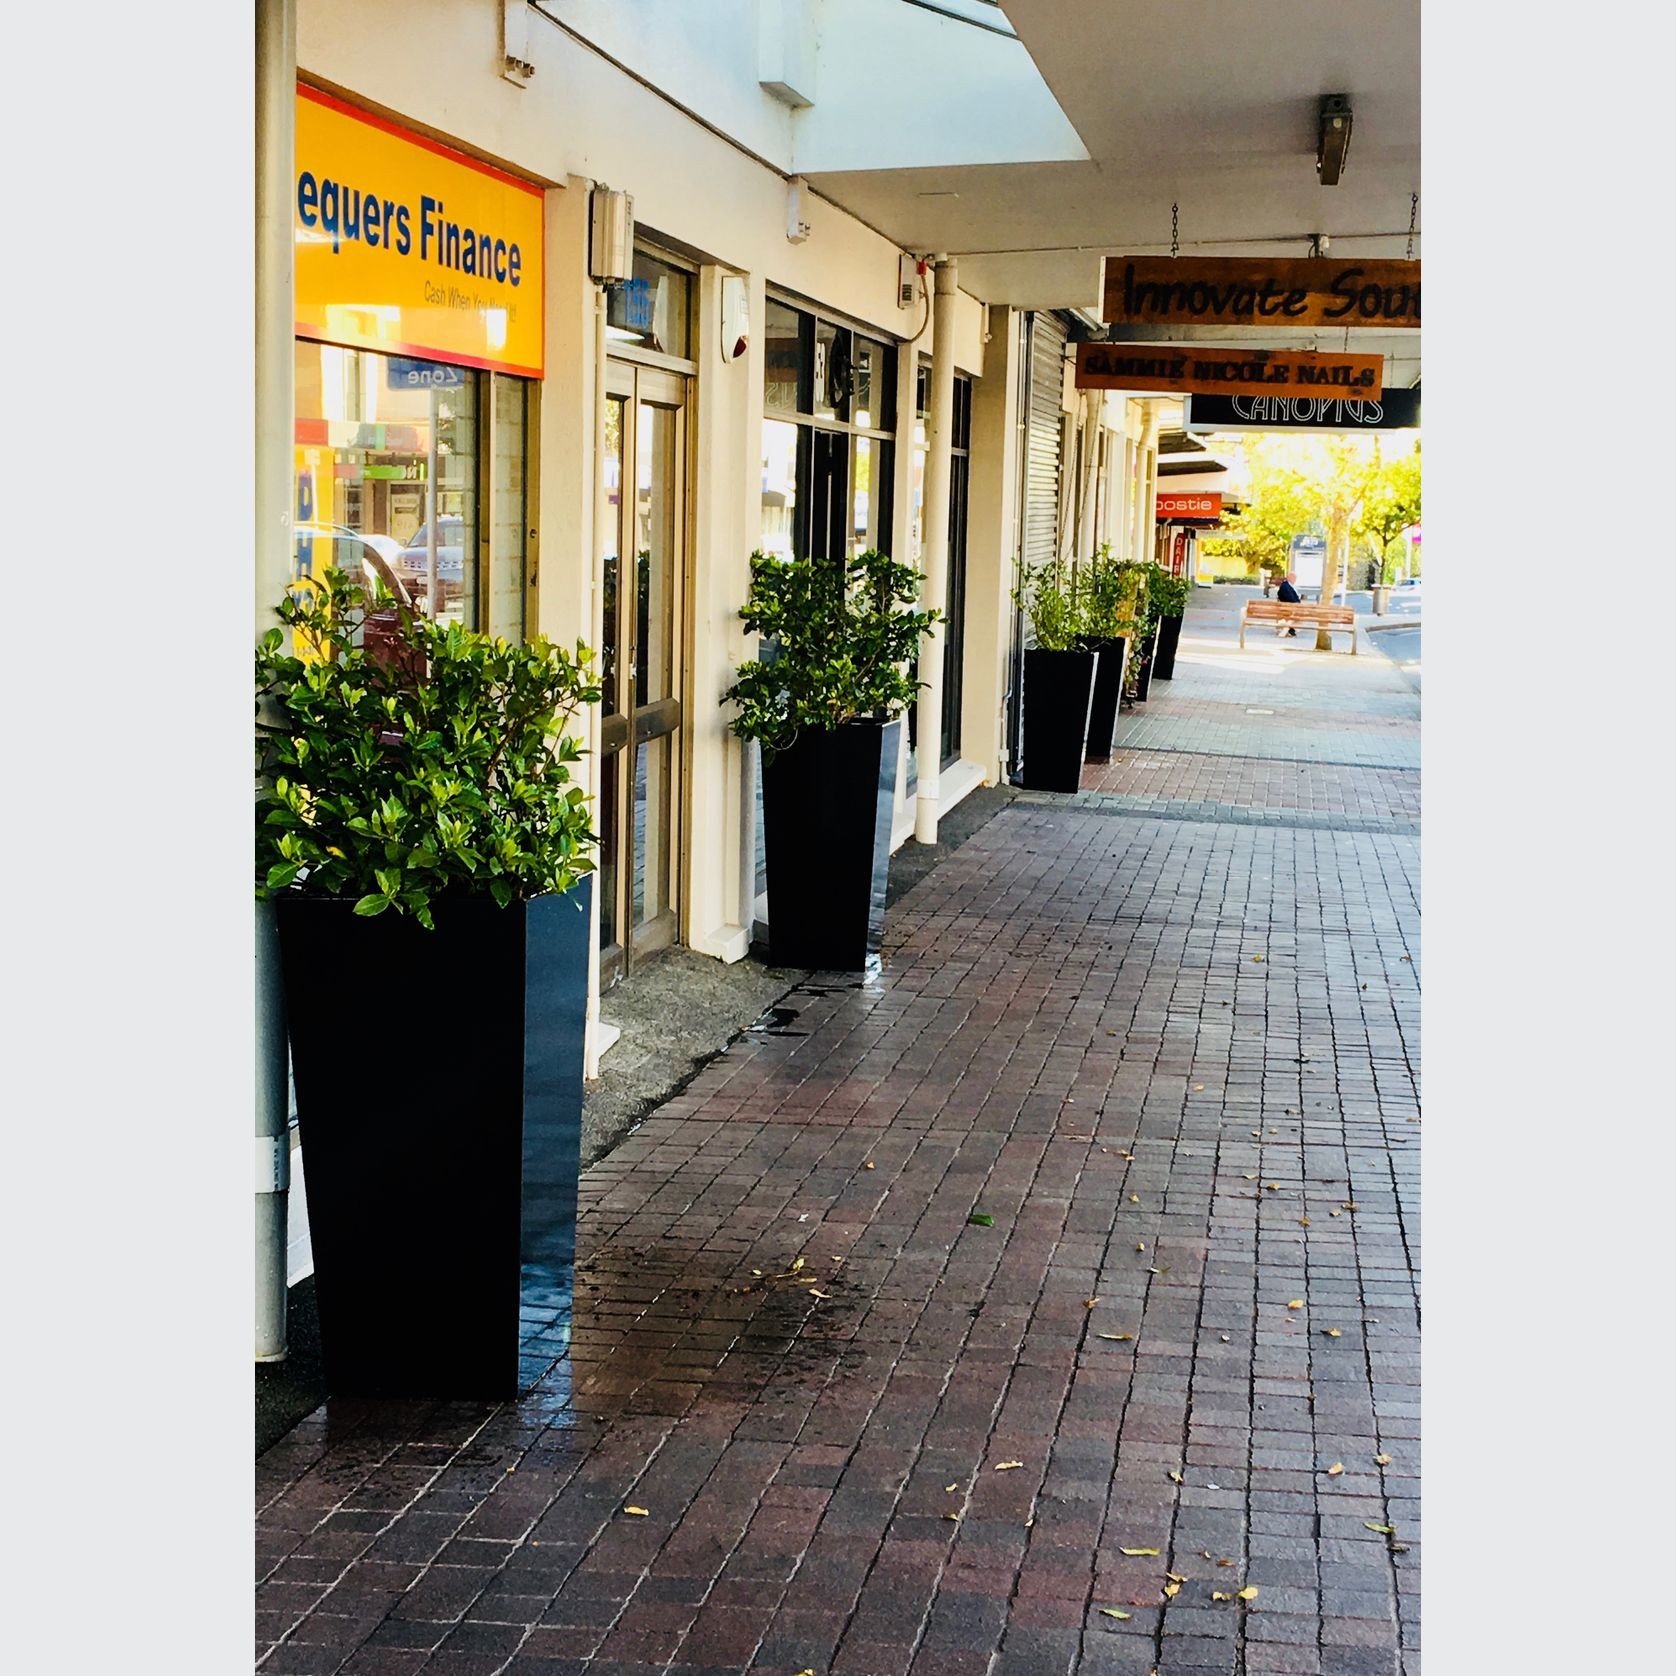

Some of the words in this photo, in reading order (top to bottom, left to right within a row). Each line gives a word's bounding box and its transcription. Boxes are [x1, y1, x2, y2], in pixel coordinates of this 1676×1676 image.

[421, 195, 521, 287] Finance
[424, 280, 446, 304] Cash
[448, 286, 471, 311] When
[1124, 263, 1309, 316] Innovate
[1084, 355, 1185, 379] SAMMIE
[1193, 361, 1290, 383] NICOLE
[1296, 364, 1376, 387] NAILS
